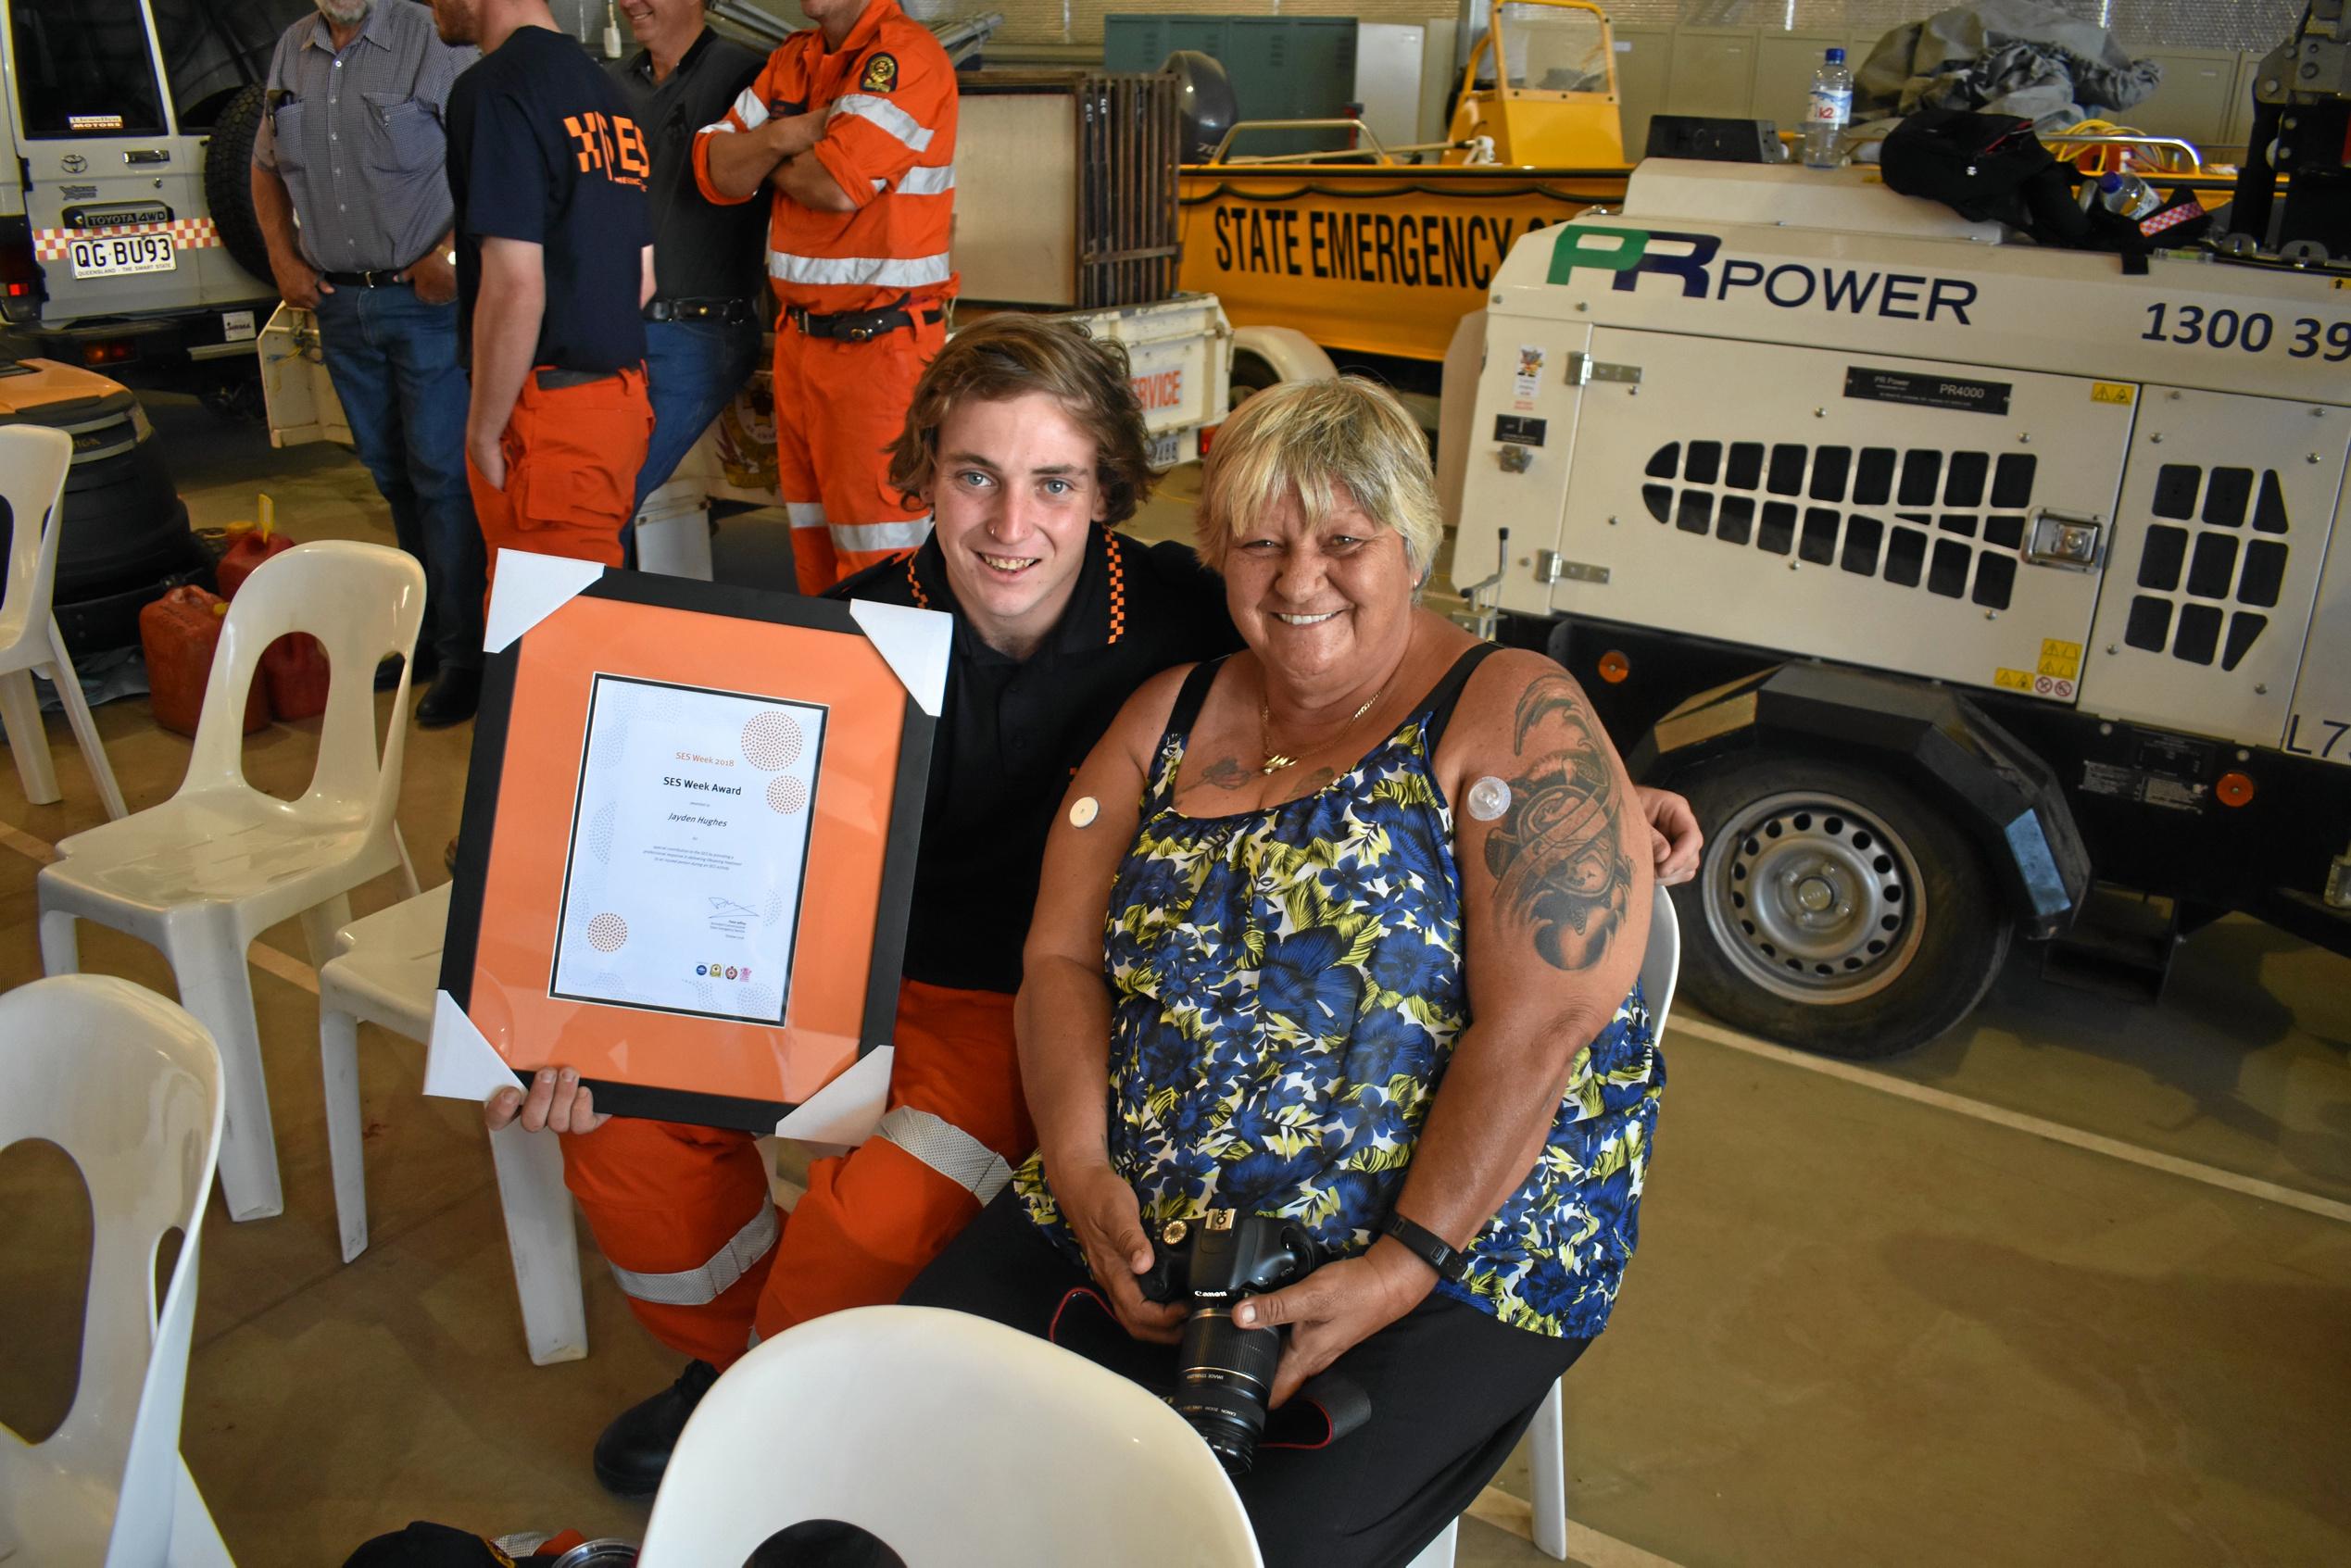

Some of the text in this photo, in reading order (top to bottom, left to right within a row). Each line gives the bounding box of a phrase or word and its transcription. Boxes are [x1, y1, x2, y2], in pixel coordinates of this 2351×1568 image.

[89, 211, 166, 225] TOYOTA 4WD
[1214, 206, 1513, 291] STATE EMERGENCY
[77, 268, 116, 277] QUEENSLAND
[1546, 224, 1978, 325] PR POWER
[2142, 302, 2351, 361] 1300 39
[1129, 370, 1181, 414] ERVICE
[1940, 383, 1985, 398] PR4000
[2286, 714, 2351, 758] L7
[675, 751, 735, 767] SES Week 2018
[663, 776, 742, 796] SES Week Award
[668, 812, 728, 827] Jayden Hughes
